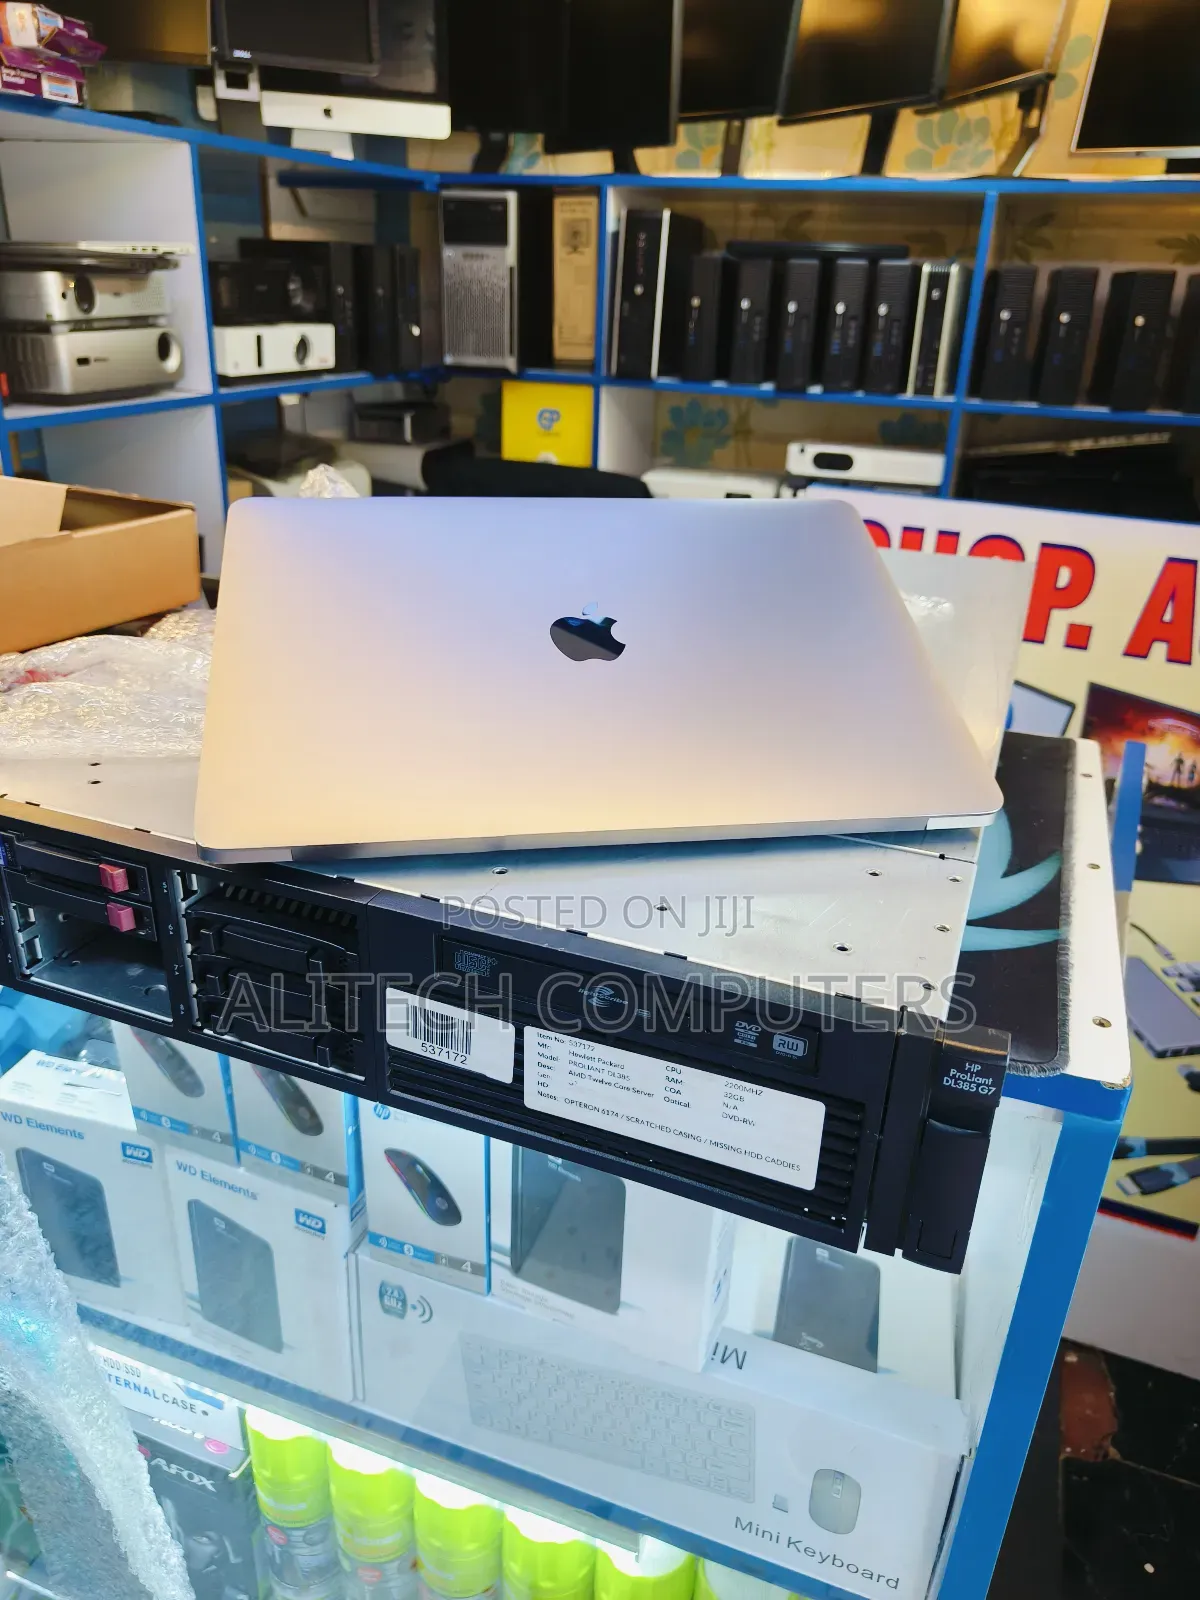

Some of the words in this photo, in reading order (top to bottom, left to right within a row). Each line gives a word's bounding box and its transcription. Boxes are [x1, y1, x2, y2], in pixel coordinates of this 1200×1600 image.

[1122, 556, 1200, 666] A
[735, 1020, 762, 1032] DVD
[537, 1032, 553, 1041] Item
[568, 1039, 596, 1052] 537172
[777, 1038, 799, 1052] RW
[421, 1042, 468, 1065] 537172
[568, 1050, 596, 1063] Hewlett
[597, 1058, 625, 1070] Packard
[568, 1060, 605, 1075] PROLIANT
[607, 1070, 631, 1082] DL385
[949, 1068, 993, 1085] ProLiant
[965, 1062, 981, 1073] HP
[568, 1069, 586, 1079] AMD
[588, 1074, 612, 1087] Twelve
[613, 1082, 631, 1092] Core
[631, 1087, 655, 1098] Server
[724, 1080, 764, 1097] 2200MHZ
[943, 1076, 977, 1092] DL385
[978, 1085, 996, 1096] G7
[723, 1091, 745, 1103] 32GB
[375, 1104, 390, 1120] hp
[1, 1111, 23, 1125] WD
[26, 1117, 85, 1140] Elements
[537, 1090, 559, 1101] Notes:
[564, 1097, 600, 1113] OPTERON
[601, 1108, 619, 1118] 6174
[625, 1115, 672, 1134] SCRATCHED
[672, 1128, 702, 1143] CASING
[709, 1139, 743, 1155] MISSING
[744, 1149, 763, 1161] HDD
[764, 1156, 801, 1172] CADDIES
[212, 1131, 222, 1143] 4
[123, 1144, 151, 1161] WD
[176, 1160, 197, 1177] WD
[201, 1170, 258, 1200] Elements
[325, 1171, 335, 1184] 4
[297, 1211, 325, 1231] WD
[461, 1260, 473, 1273] 4
[711, 1342, 747, 1370] Mi
[104, 1373, 160, 1400] TERNAL
[162, 1393, 197, 1416] CASE
[150, 1457, 217, 1493] AFOX
[734, 1516, 780, 1544] Mini
[787, 1536, 899, 1590] Keyboard
